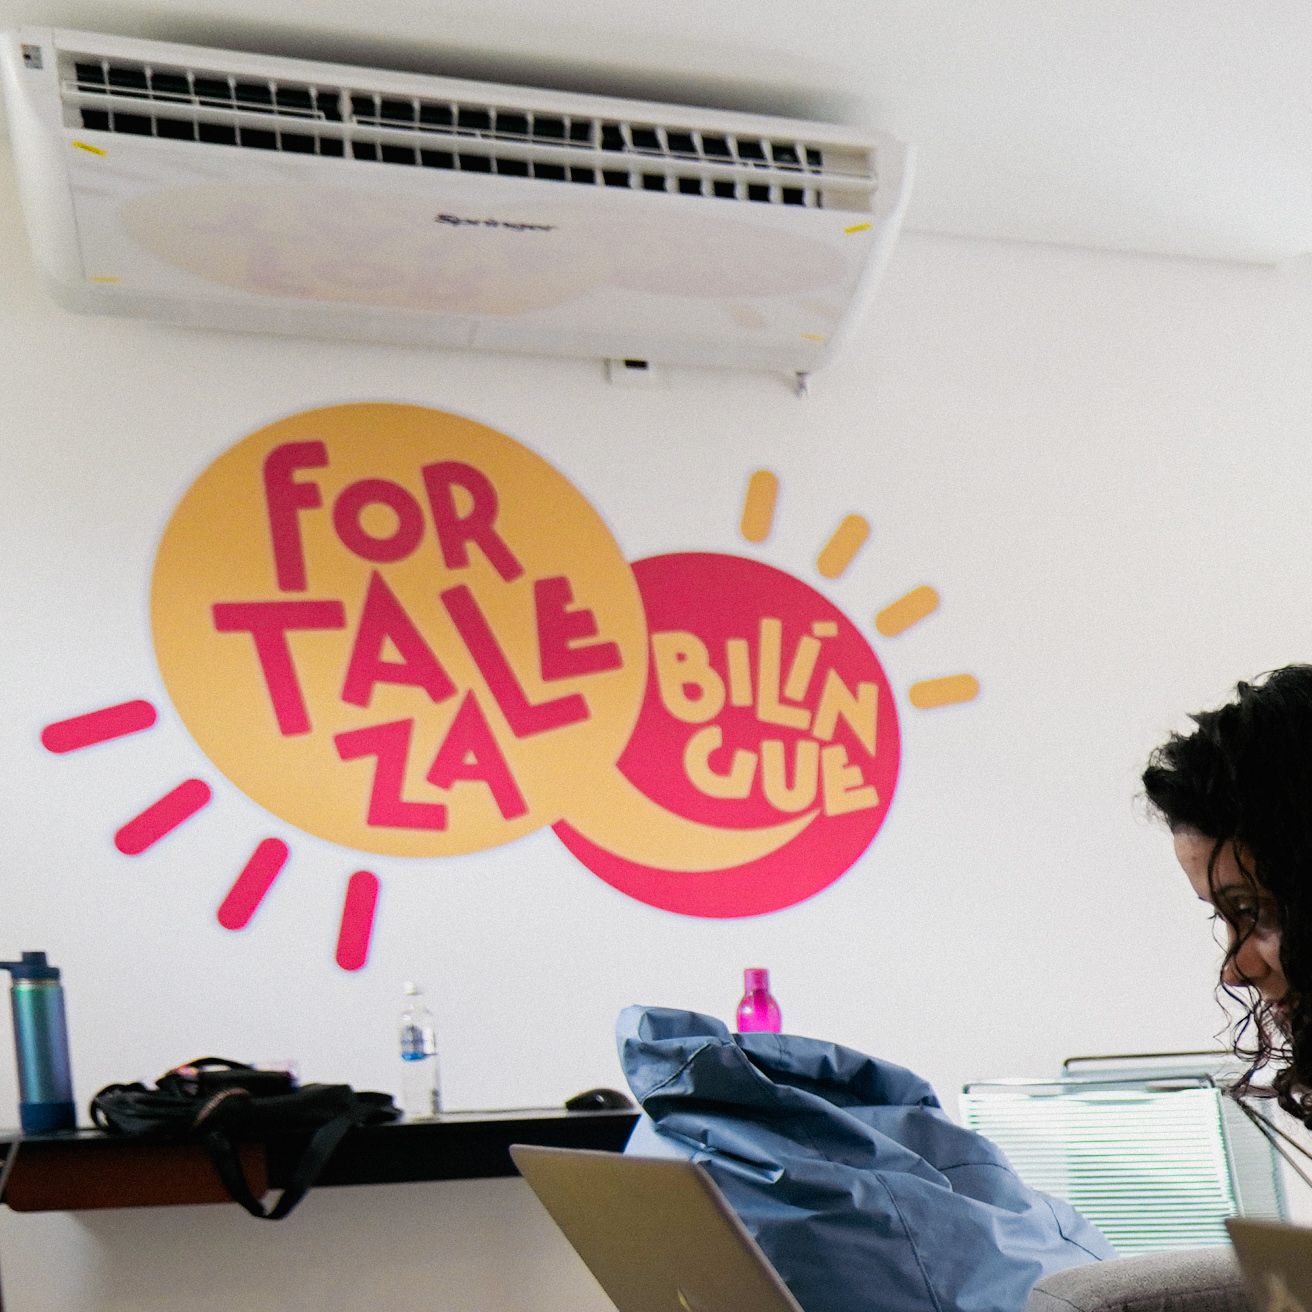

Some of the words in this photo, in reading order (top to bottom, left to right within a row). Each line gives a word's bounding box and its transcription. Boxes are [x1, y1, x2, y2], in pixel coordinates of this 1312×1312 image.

[263, 440, 524, 593] FOR
[211, 569, 623, 740] TALE
[650, 617, 879, 759] BILÍN
[333, 689, 528, 832] ZA
[682, 724, 880, 817] GUE
